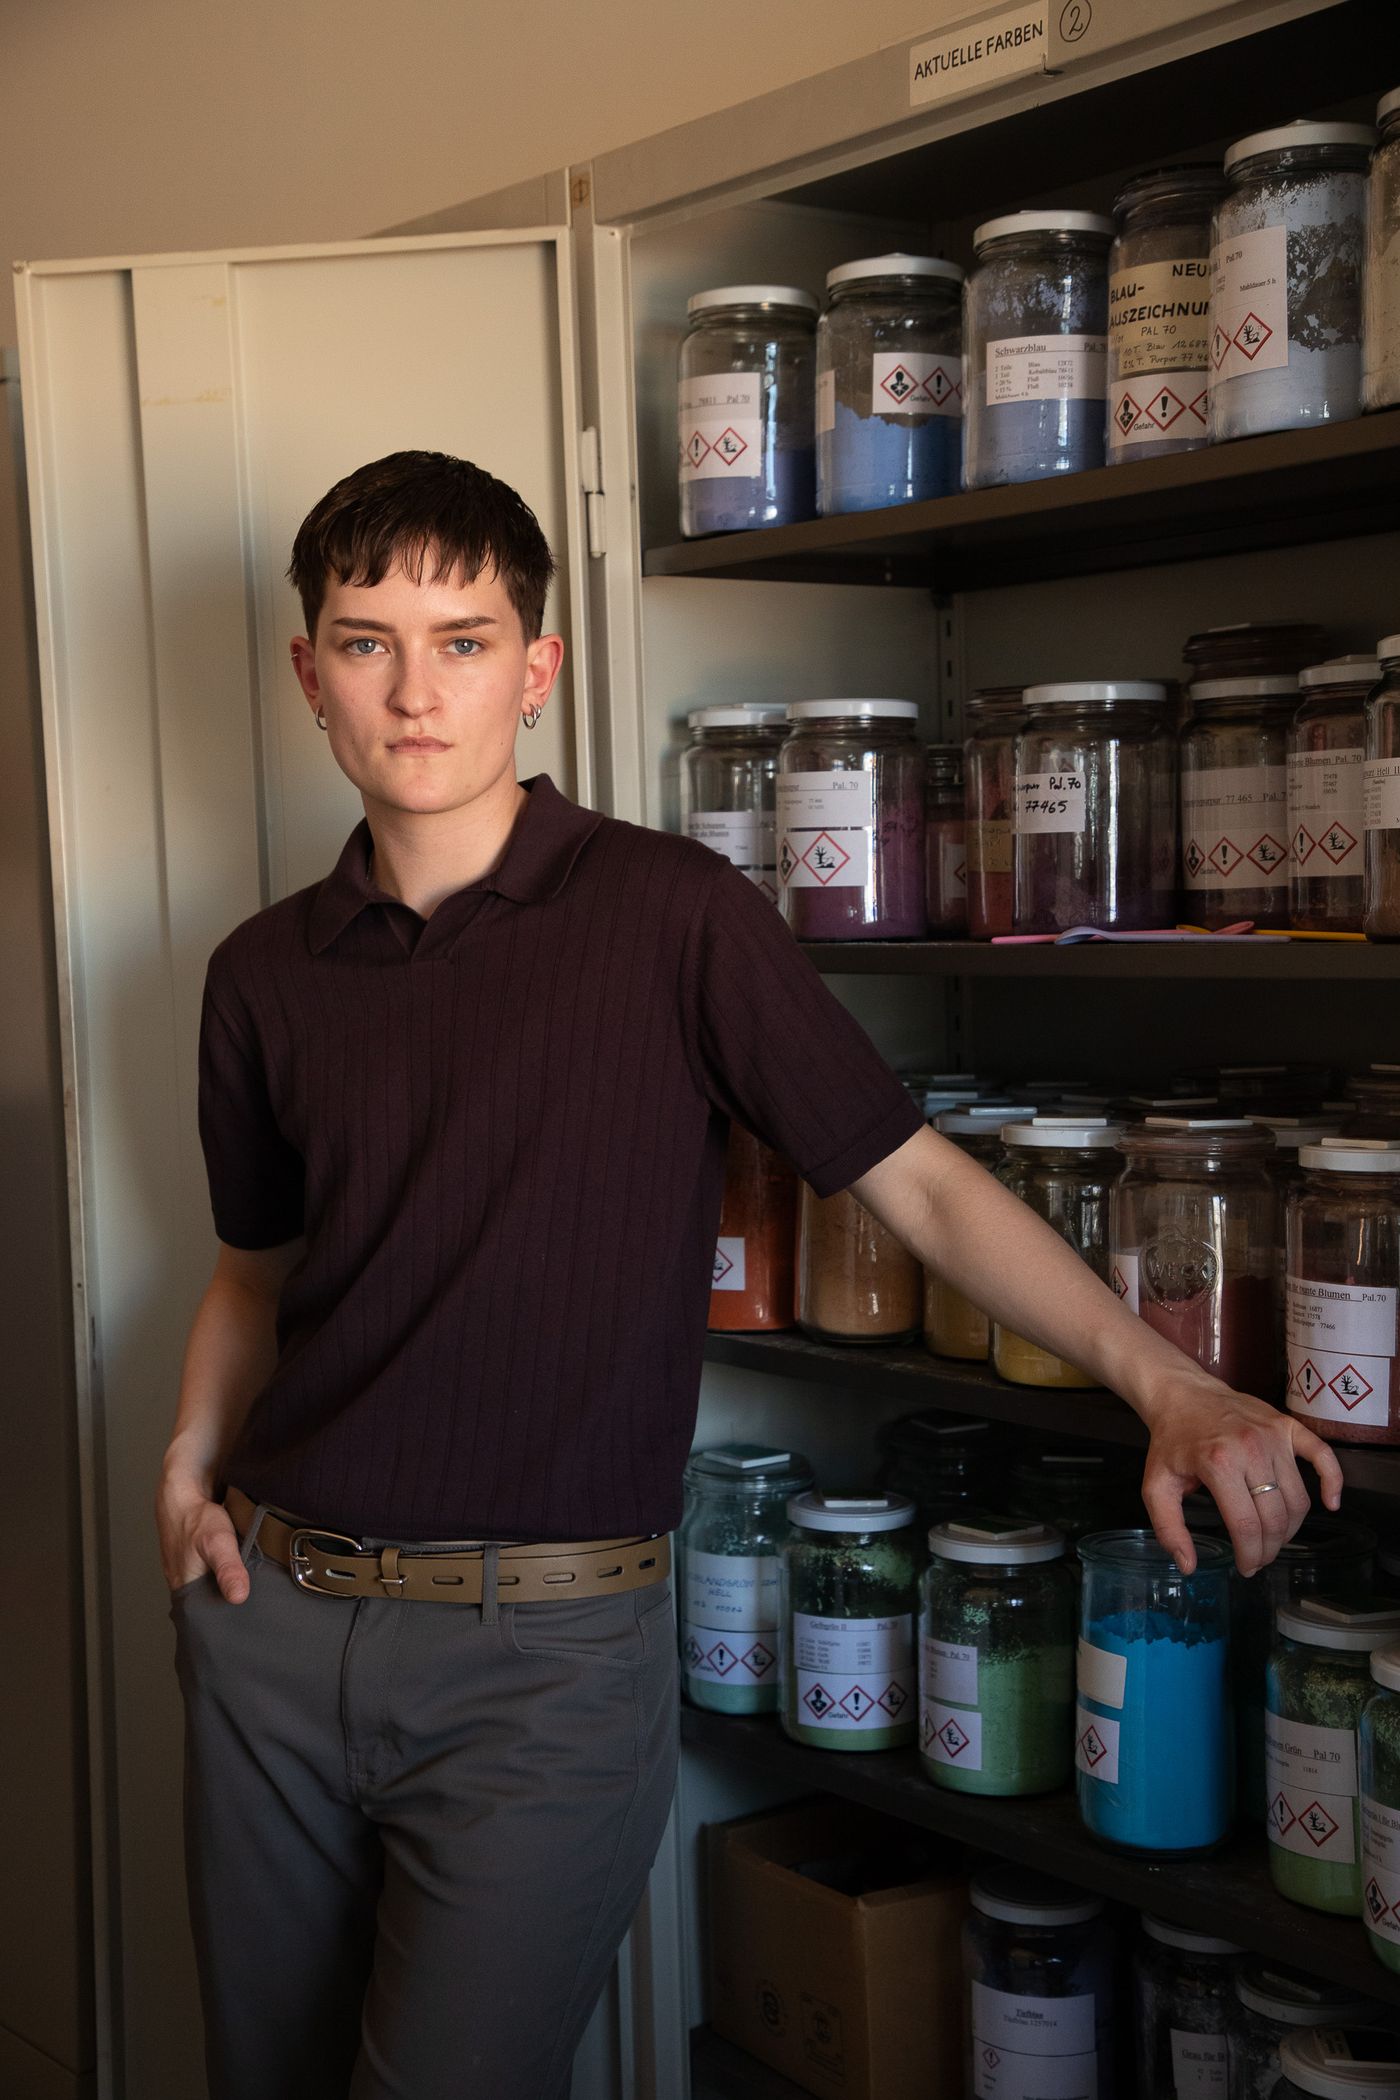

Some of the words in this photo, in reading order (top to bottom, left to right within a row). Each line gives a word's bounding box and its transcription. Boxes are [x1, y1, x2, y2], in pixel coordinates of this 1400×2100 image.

[1070, 6, 1083, 36] 2
[914, 40, 983, 81] AKTUELLE
[986, 20, 1043, 56] FARBEN
[1110, 283, 1145, 304] BLAU-
[1140, 326, 1159, 336] PAL
[1163, 324, 1177, 334] 70
[995, 343, 1047, 357] Schwarzblau
[1133, 422, 1155, 431] Gefahr
[1352, 754, 1362, 763] 70
[849, 781, 859, 789] 70
[1049, 776, 1066, 790] Pal.
[1318, 1288, 1350, 1300] Blumen
[1329, 1752, 1340, 1762] 70
